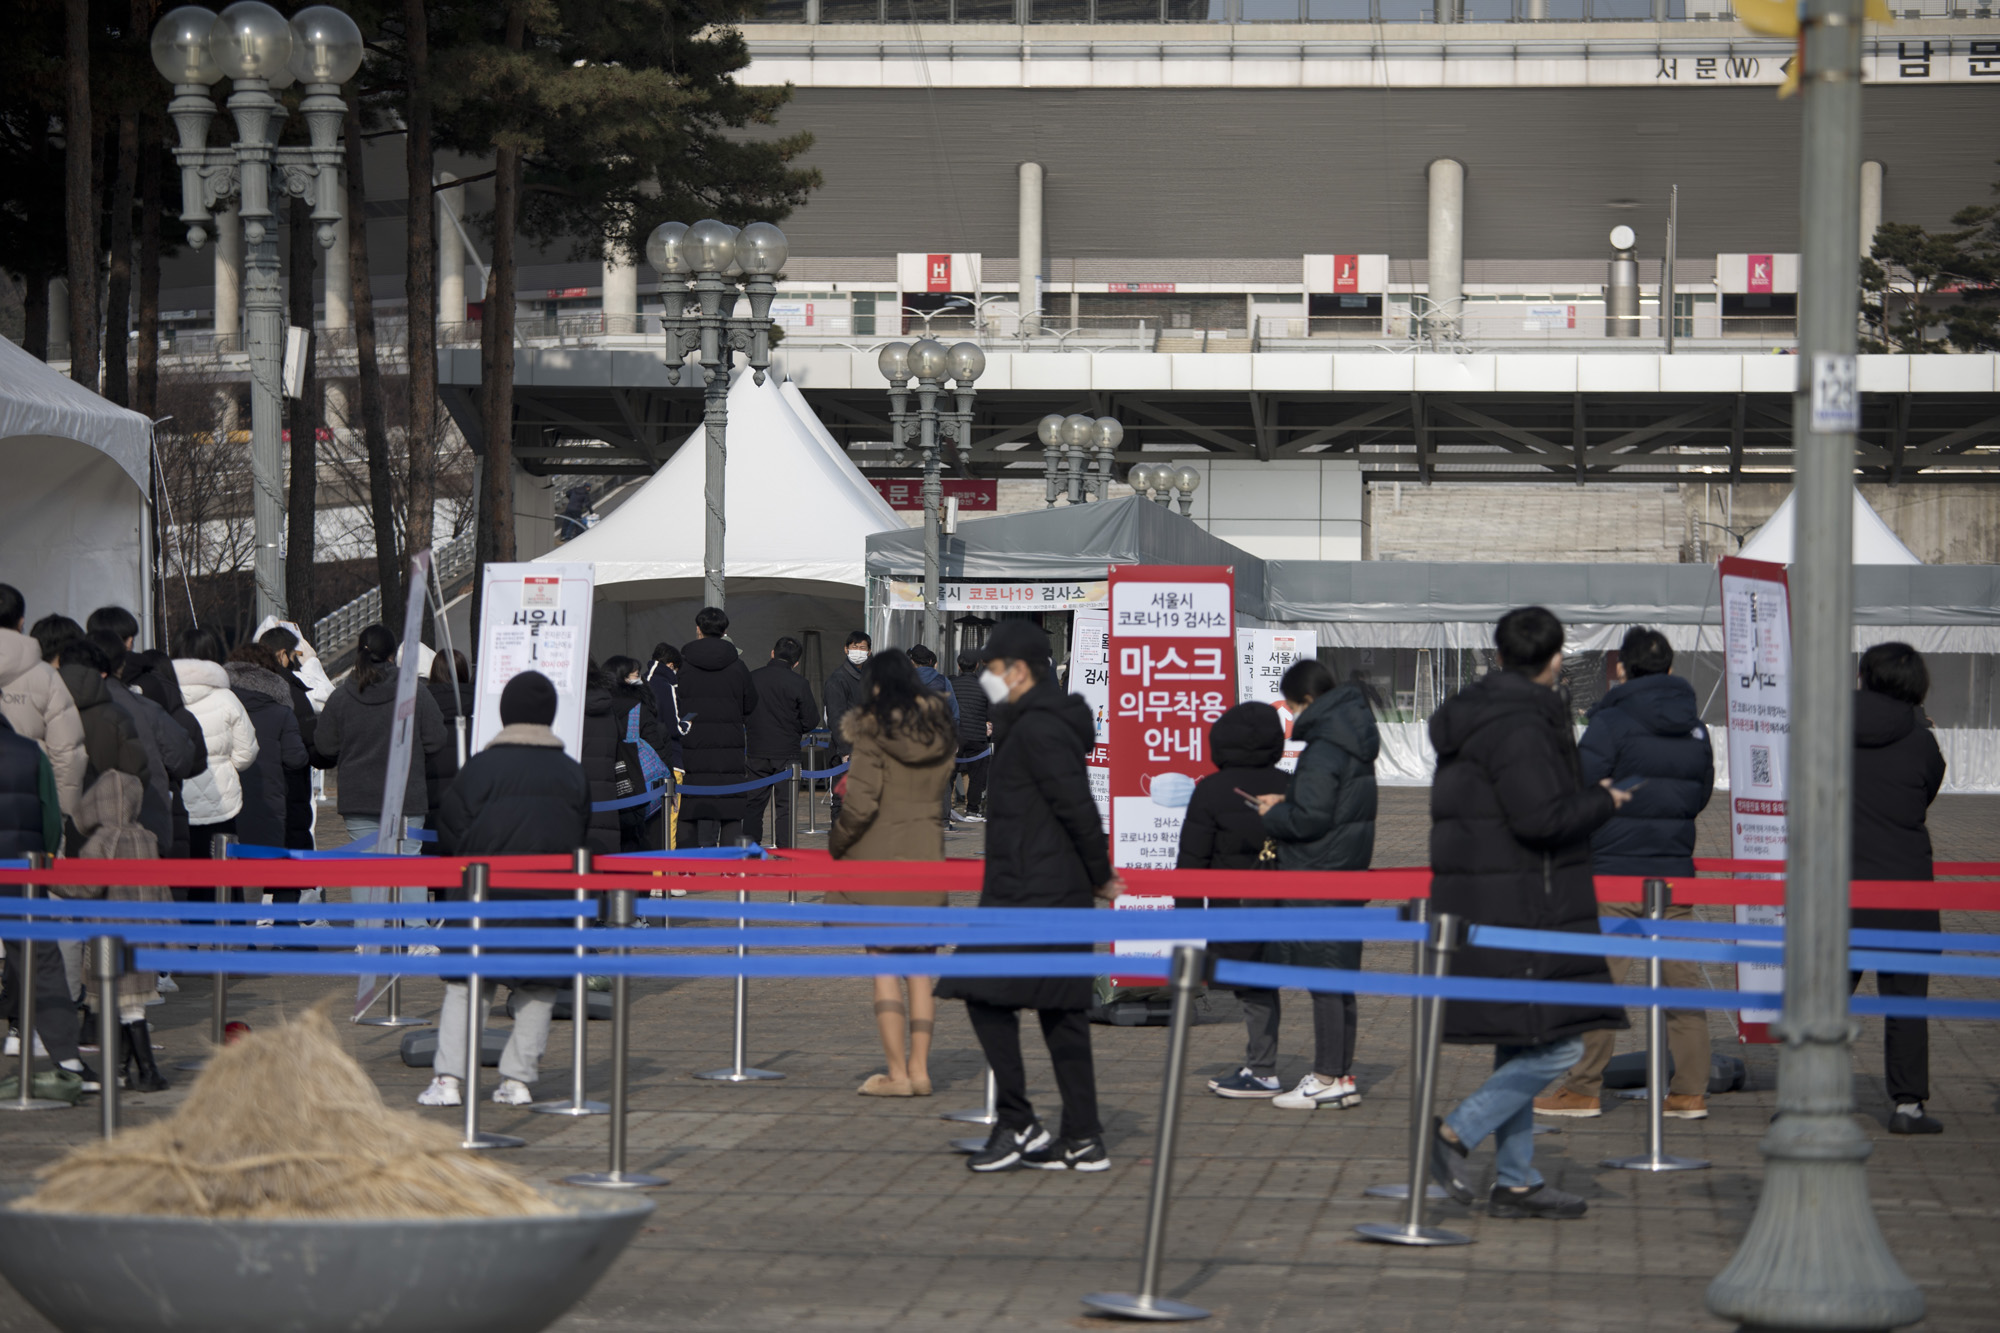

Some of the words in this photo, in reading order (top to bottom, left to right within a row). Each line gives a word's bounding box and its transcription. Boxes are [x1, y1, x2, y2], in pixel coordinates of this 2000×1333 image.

[933, 263, 945, 278] H
[1342, 263, 1350, 279] J
[1754, 263, 1767, 279] K
[968, 586, 1034, 602] 코로나19
[1041, 586, 1086, 601] 검사소
[1150, 591, 1194, 609] 서울시
[1117, 611, 1180, 628] 코로나19
[1184, 611, 1227, 628] 검사소
[1120, 645, 1226, 687] 마스크
[1118, 690, 1227, 723] 의무착용
[1144, 727, 1202, 762] 안내
[1153, 817, 1180, 829] 검사소
[1119, 832, 1158, 843] 코로나19
[1140, 847, 1176, 858] 마스크를
